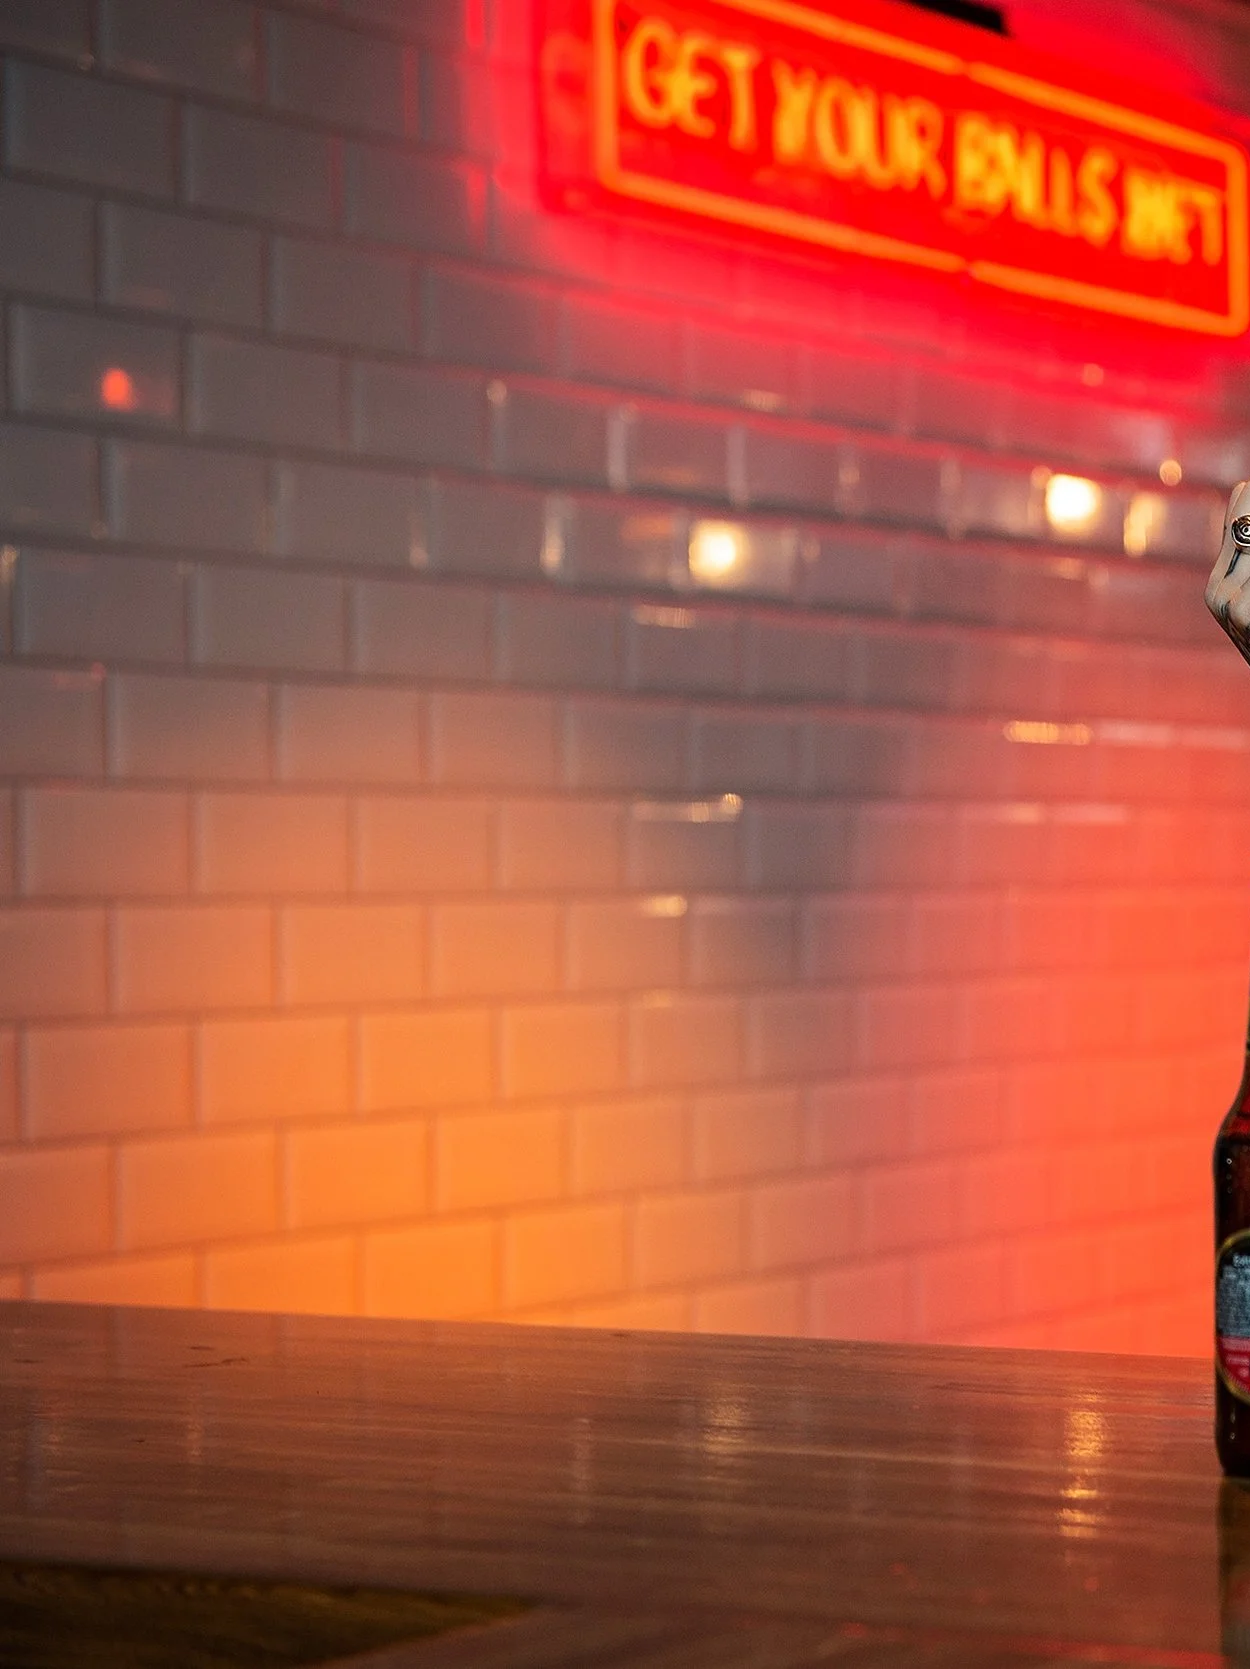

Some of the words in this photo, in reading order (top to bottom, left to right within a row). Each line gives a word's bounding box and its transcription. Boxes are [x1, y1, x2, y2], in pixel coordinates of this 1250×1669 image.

[624, 17, 756, 152] GET
[773, 60, 947, 197] YOUR
[955, 114, 1118, 247] BALLS
